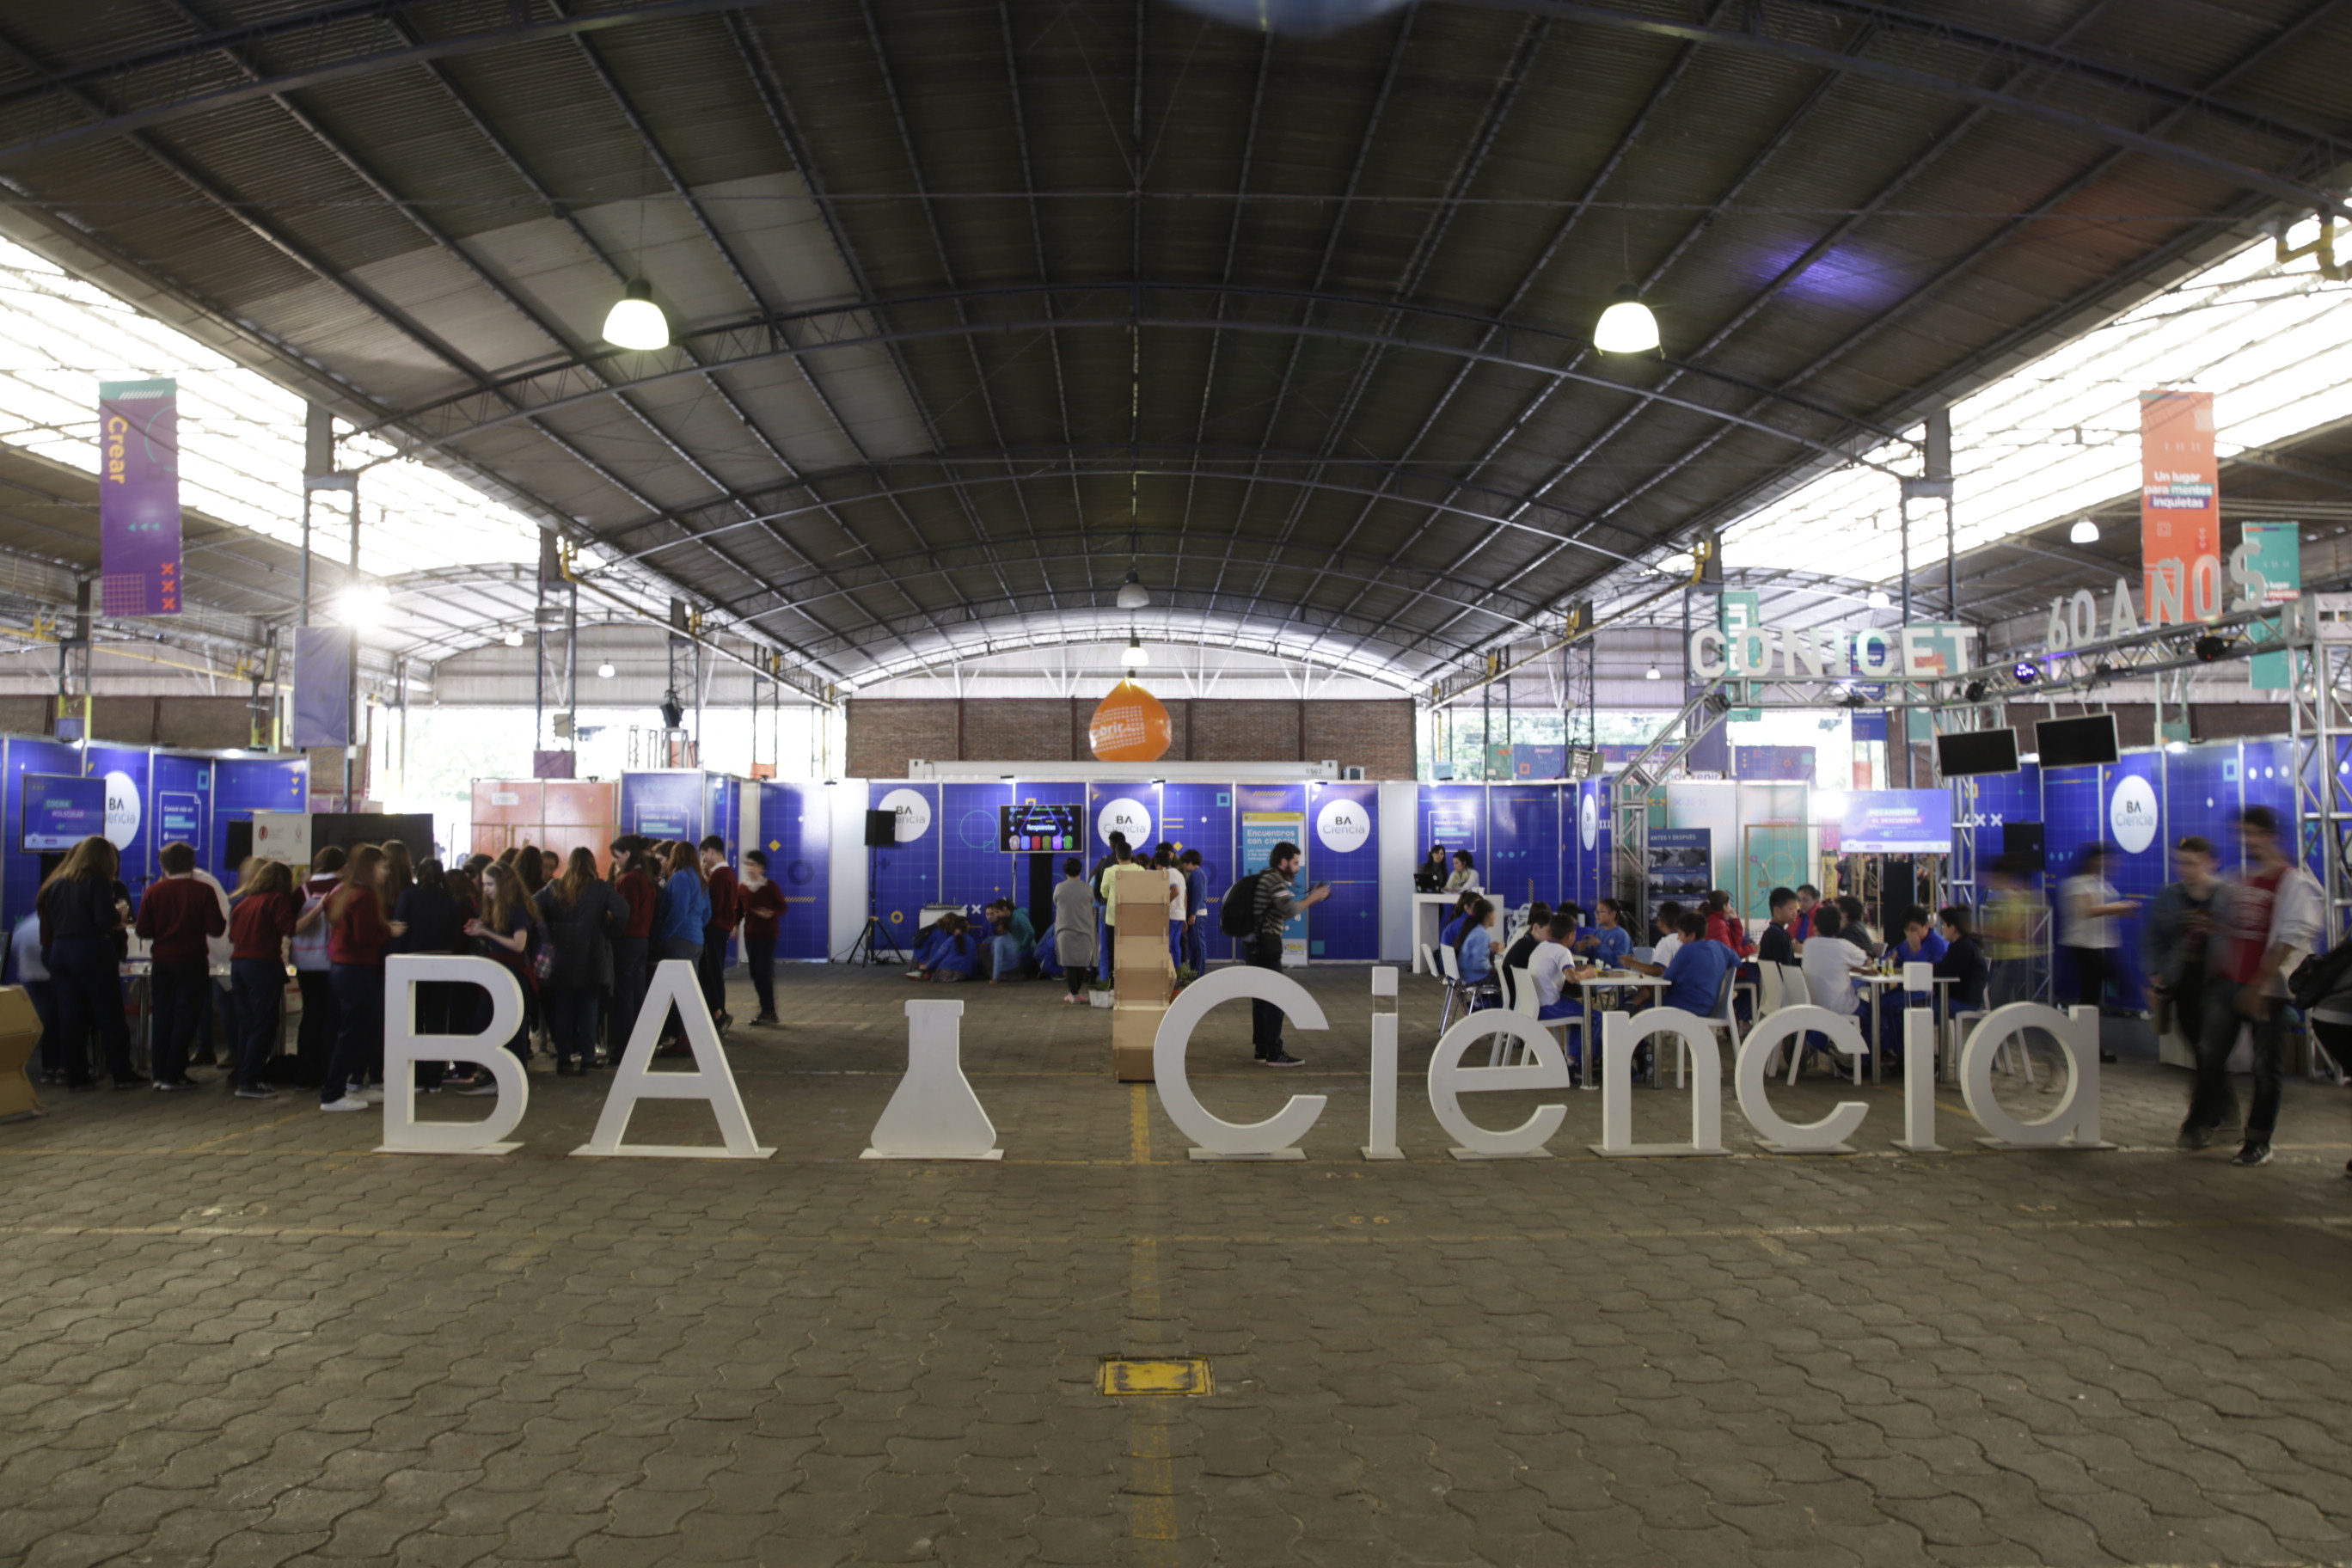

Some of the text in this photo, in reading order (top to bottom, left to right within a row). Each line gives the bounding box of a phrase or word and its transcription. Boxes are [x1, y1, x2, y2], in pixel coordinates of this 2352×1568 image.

[107, 415, 128, 485] Crear
[2154, 470, 2201, 484] Un lugar
[2144, 485, 2213, 496] para mentes
[2153, 496, 2204, 509] inquietas
[2047, 542, 2266, 652] 60 AÑOS
[1690, 627, 1978, 677] CONICET
[109, 798, 124, 811] BA
[896, 806, 913, 815] BA
[2126, 800, 2142, 814] BA
[1116, 815, 1133, 824] BA
[1335, 816, 1352, 825] BA
[2116, 812, 2154, 827] Ciencia
[1026, 824, 1057, 832] Respuestas
[1103, 824, 1146, 834] Ciencia
[1246, 829, 1295, 837] Encuentros
[1322, 824, 1365, 835] Ciencia
[1153, 960, 2100, 1155] Ciencia
